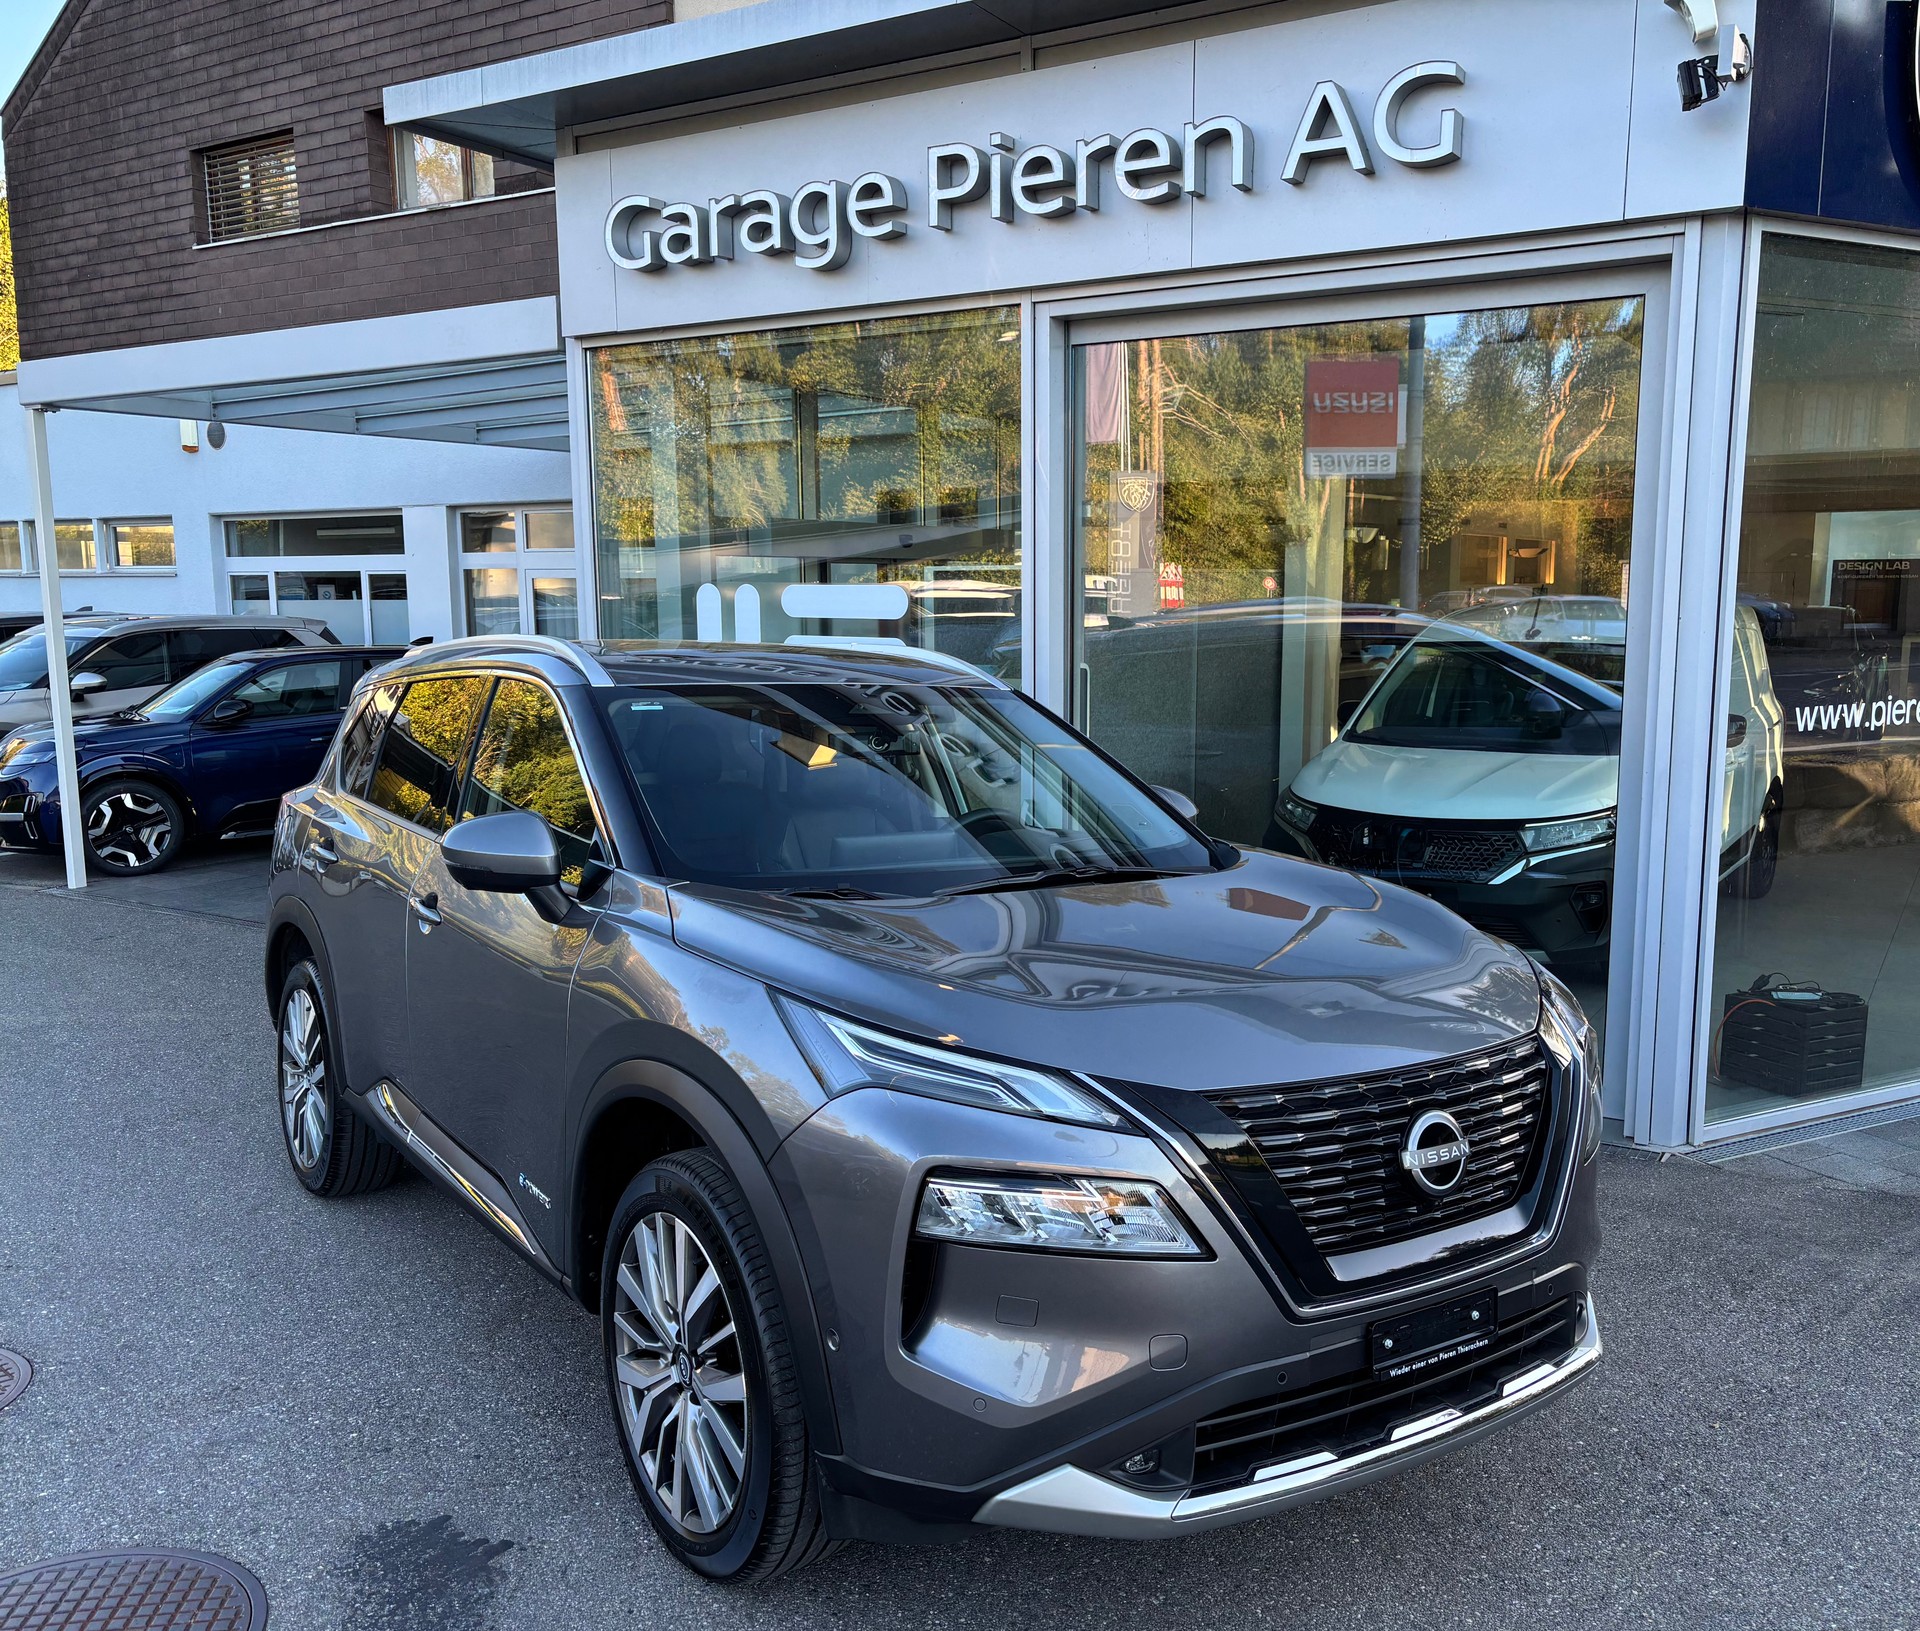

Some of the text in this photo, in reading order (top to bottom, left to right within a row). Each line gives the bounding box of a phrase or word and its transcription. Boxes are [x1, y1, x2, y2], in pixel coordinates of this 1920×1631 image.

[605, 60, 1465, 272] Garage Pieren AG
[1838, 561, 1911, 571] DESIGN LAB
[1405, 1141, 1469, 1167] NISSAN
[1389, 1339, 1489, 1377] Wieder einer von Pieren Thierachern
